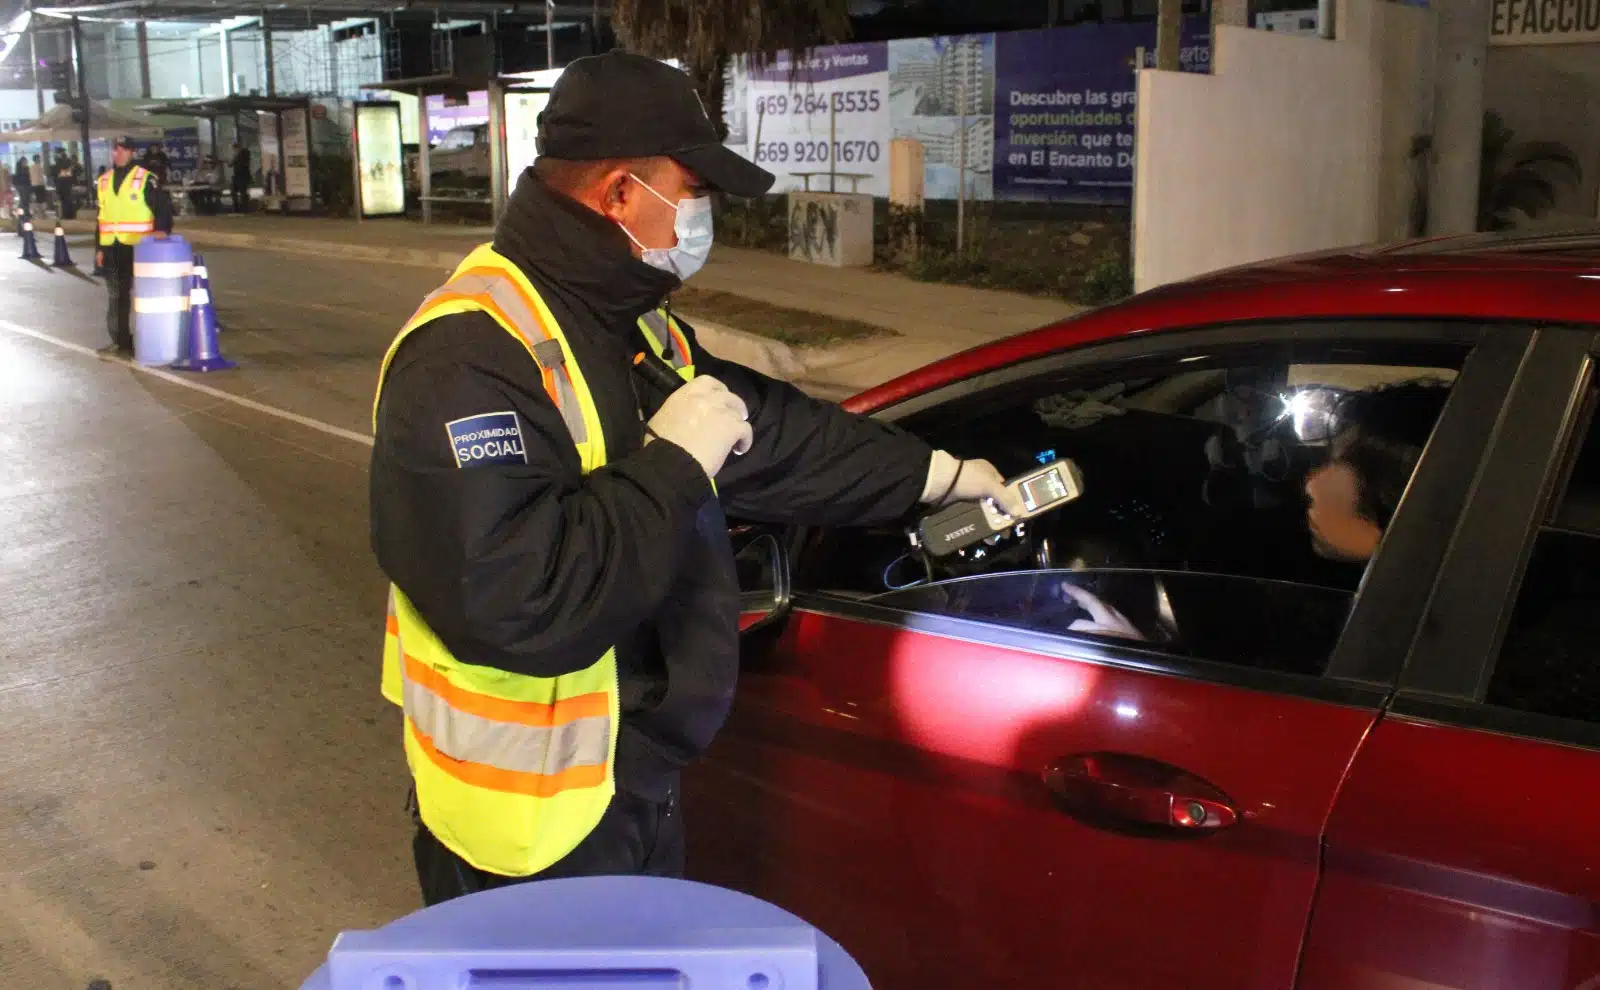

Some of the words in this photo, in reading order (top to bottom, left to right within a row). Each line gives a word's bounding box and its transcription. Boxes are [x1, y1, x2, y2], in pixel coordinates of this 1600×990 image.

[793, 92, 828, 114] 264
[834, 90, 880, 112] 3535
[1010, 89, 1081, 106] Descubre
[1085, 89, 1108, 105] las
[1010, 109, 1122, 127] oportunidades
[1010, 129, 1077, 145] inversión
[1081, 133, 1112, 150] que
[1116, 131, 1133, 146] te
[756, 142, 788, 162] 669
[795, 141, 828, 161] 920
[832, 140, 880, 161] 1670
[1008, 152, 1027, 165] en
[1031, 150, 1045, 165] El
[1049, 150, 1113, 167] Encanto
[454, 427, 518, 445] PROXIMIDAD
[458, 440, 524, 462] SOCIAL
